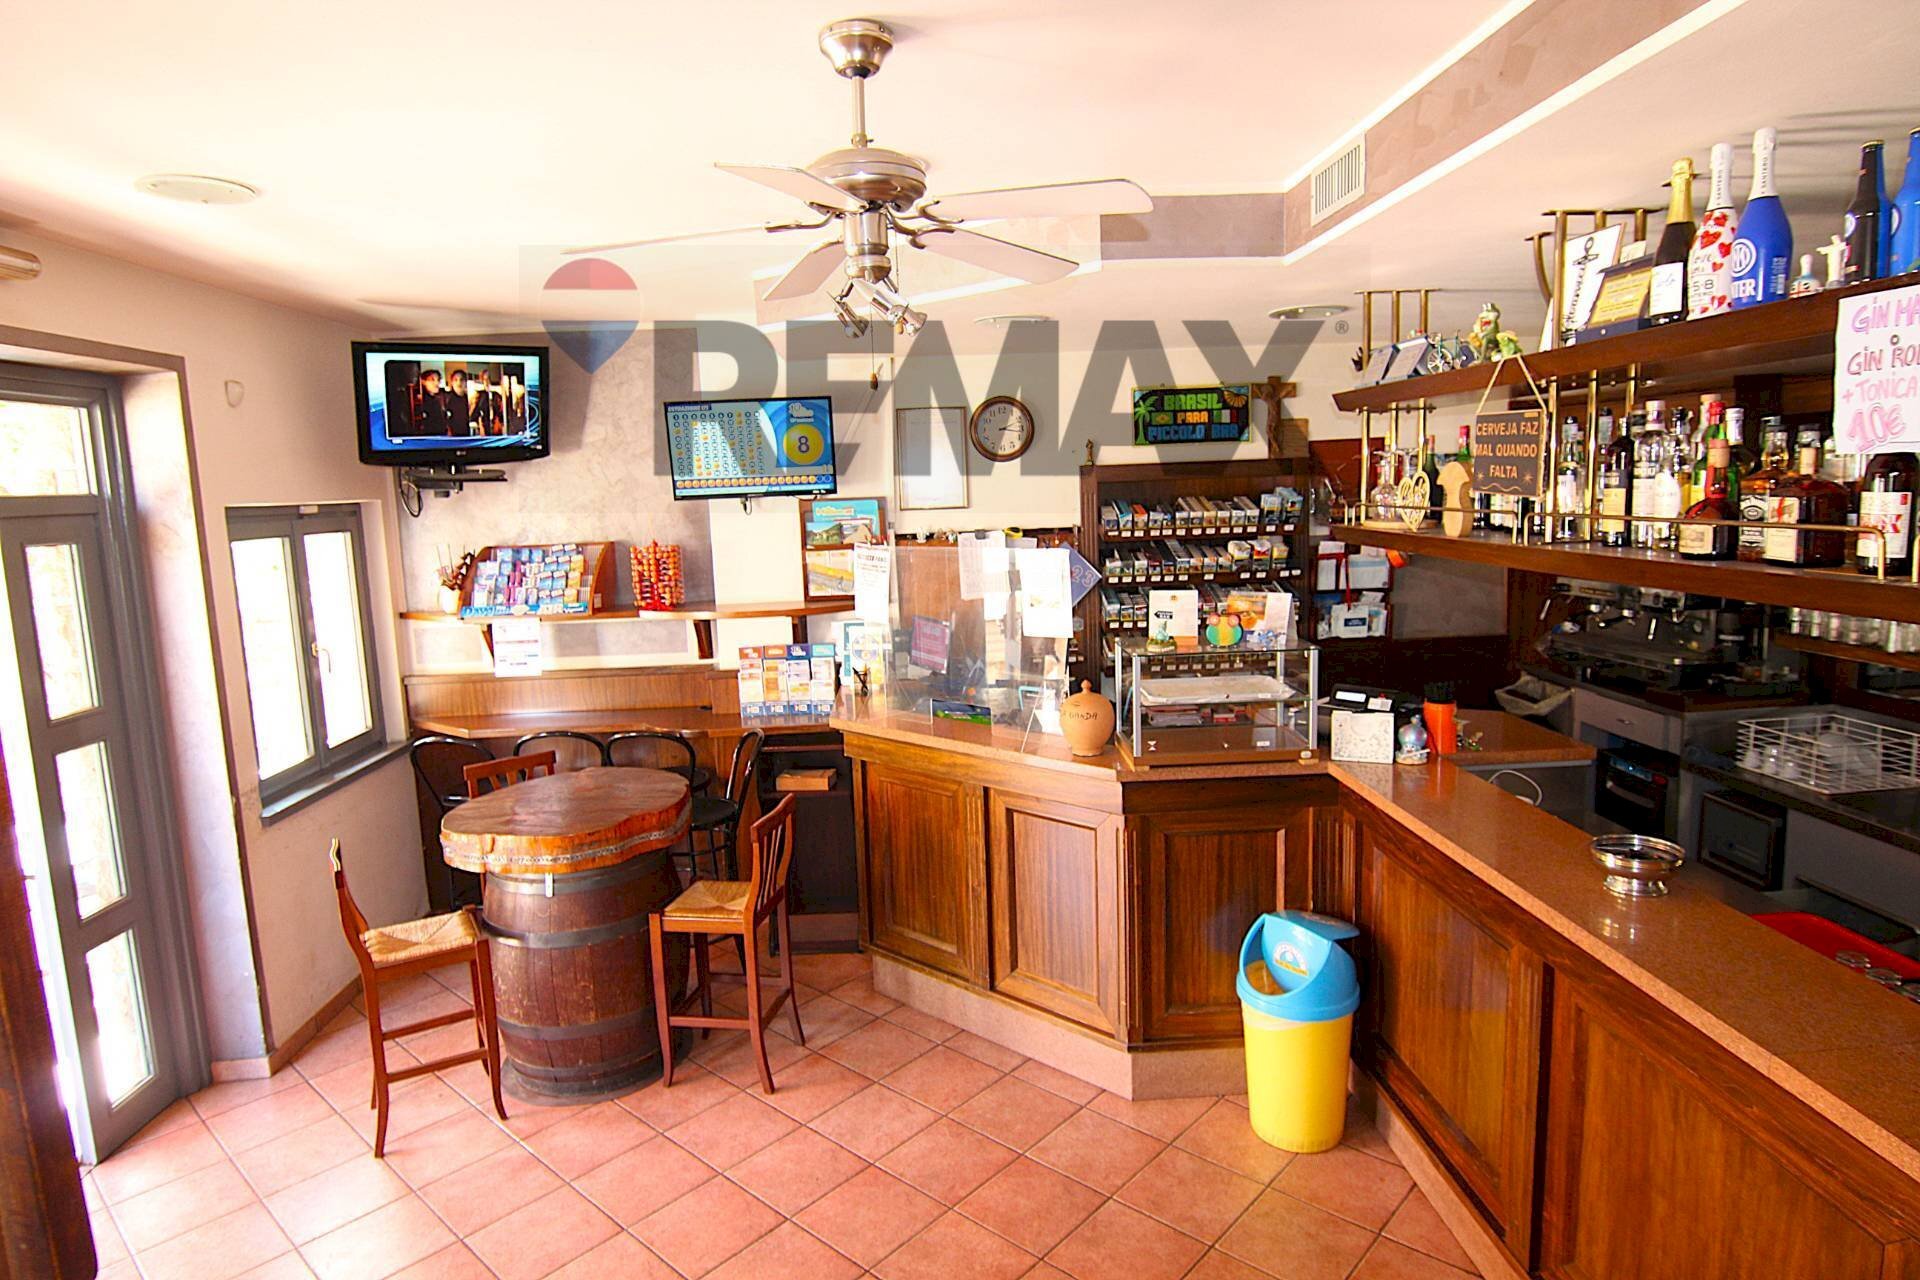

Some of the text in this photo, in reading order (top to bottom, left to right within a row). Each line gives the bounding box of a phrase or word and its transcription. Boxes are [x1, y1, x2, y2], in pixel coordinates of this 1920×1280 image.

[1851, 297, 1890, 334] GIN
[1847, 342, 1920, 376] GIN RO
[1855, 373, 1918, 403] TONICA
[1163, 393, 1223, 411] BRASIL
[1176, 411, 1209, 424] PARA
[1148, 424, 1239, 441] PICCOLO BAR
[1476, 421, 1539, 436] CERVEJA FAZ
[798, 435, 810, 453] 8
[1475, 443, 1538, 457] MAL QUANDO
[1489, 464, 1518, 479] FALTA
